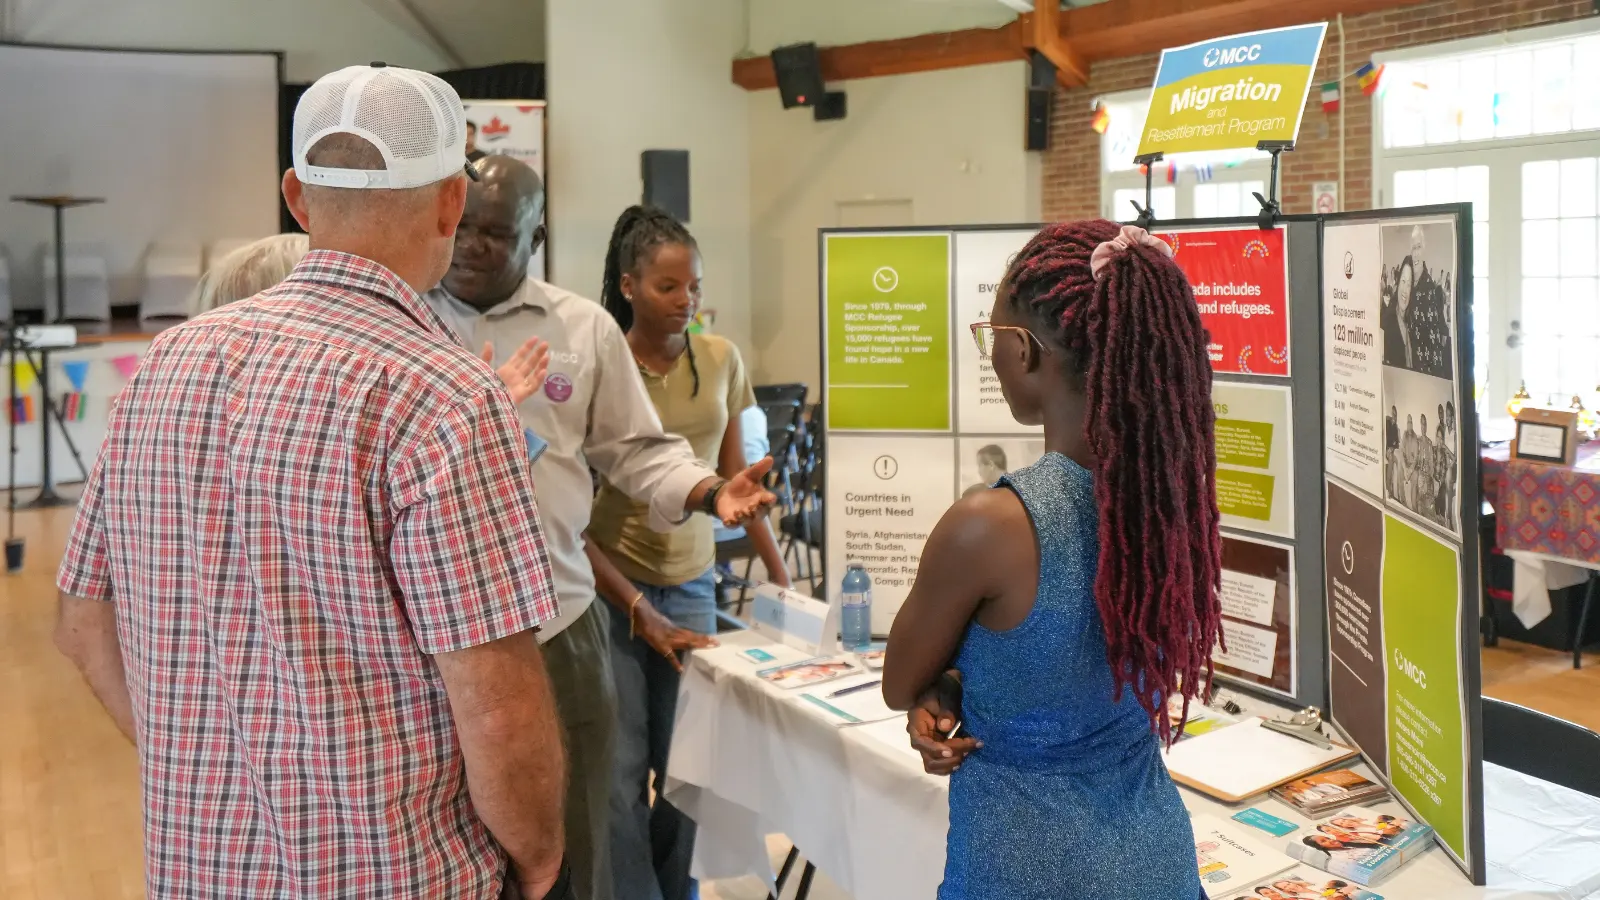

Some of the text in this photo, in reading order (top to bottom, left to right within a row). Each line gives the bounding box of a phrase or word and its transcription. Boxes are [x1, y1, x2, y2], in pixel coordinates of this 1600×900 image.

[1220, 44, 1262, 66] MCC
[1169, 77, 1281, 115] Migration
[1207, 106, 1228, 119] and
[1147, 116, 1286, 144] Resettlement Program
[1213, 282, 1261, 296] includes
[1333, 288, 1348, 300] Global
[894, 303, 927, 312] through
[1198, 301, 1274, 318] and refugees.
[1333, 304, 1366, 319] Displacement
[868, 313, 902, 322] Refugee
[845, 324, 900, 332] Sponsorship,
[874, 335, 910, 344] refugees
[1333, 324, 1374, 347] 123 million
[845, 492, 911, 503] Countries in
[845, 506, 914, 518] Urgent Need
[846, 531, 928, 541] Syria, Afghanistan
[846, 542, 906, 552] South Sudan,
[875, 578, 904, 586] Congo
[1403, 658, 1426, 689] MCC
[1217, 834, 1256, 856] Suitcases
